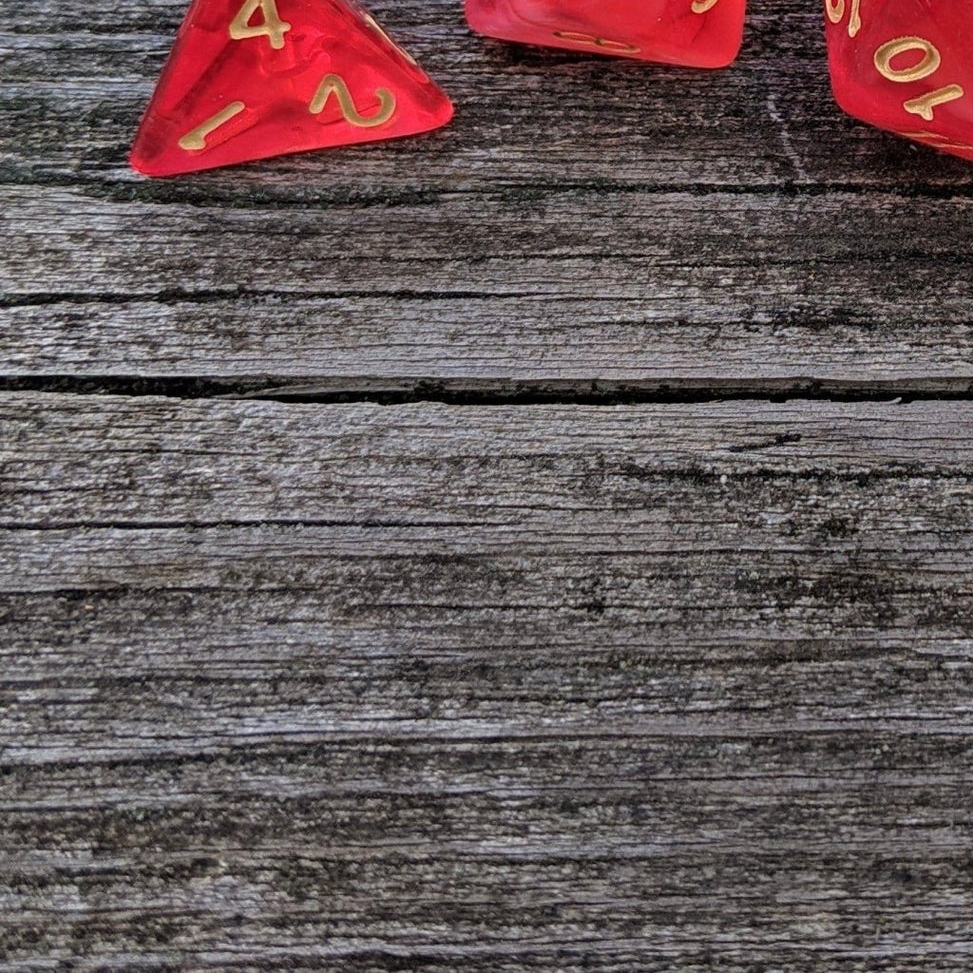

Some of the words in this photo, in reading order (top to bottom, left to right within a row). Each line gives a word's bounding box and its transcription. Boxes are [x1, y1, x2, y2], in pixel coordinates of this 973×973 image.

[309, 74, 396, 127] 2
[873, 35, 965, 121] 10
[178, 101, 246, 150] 1
